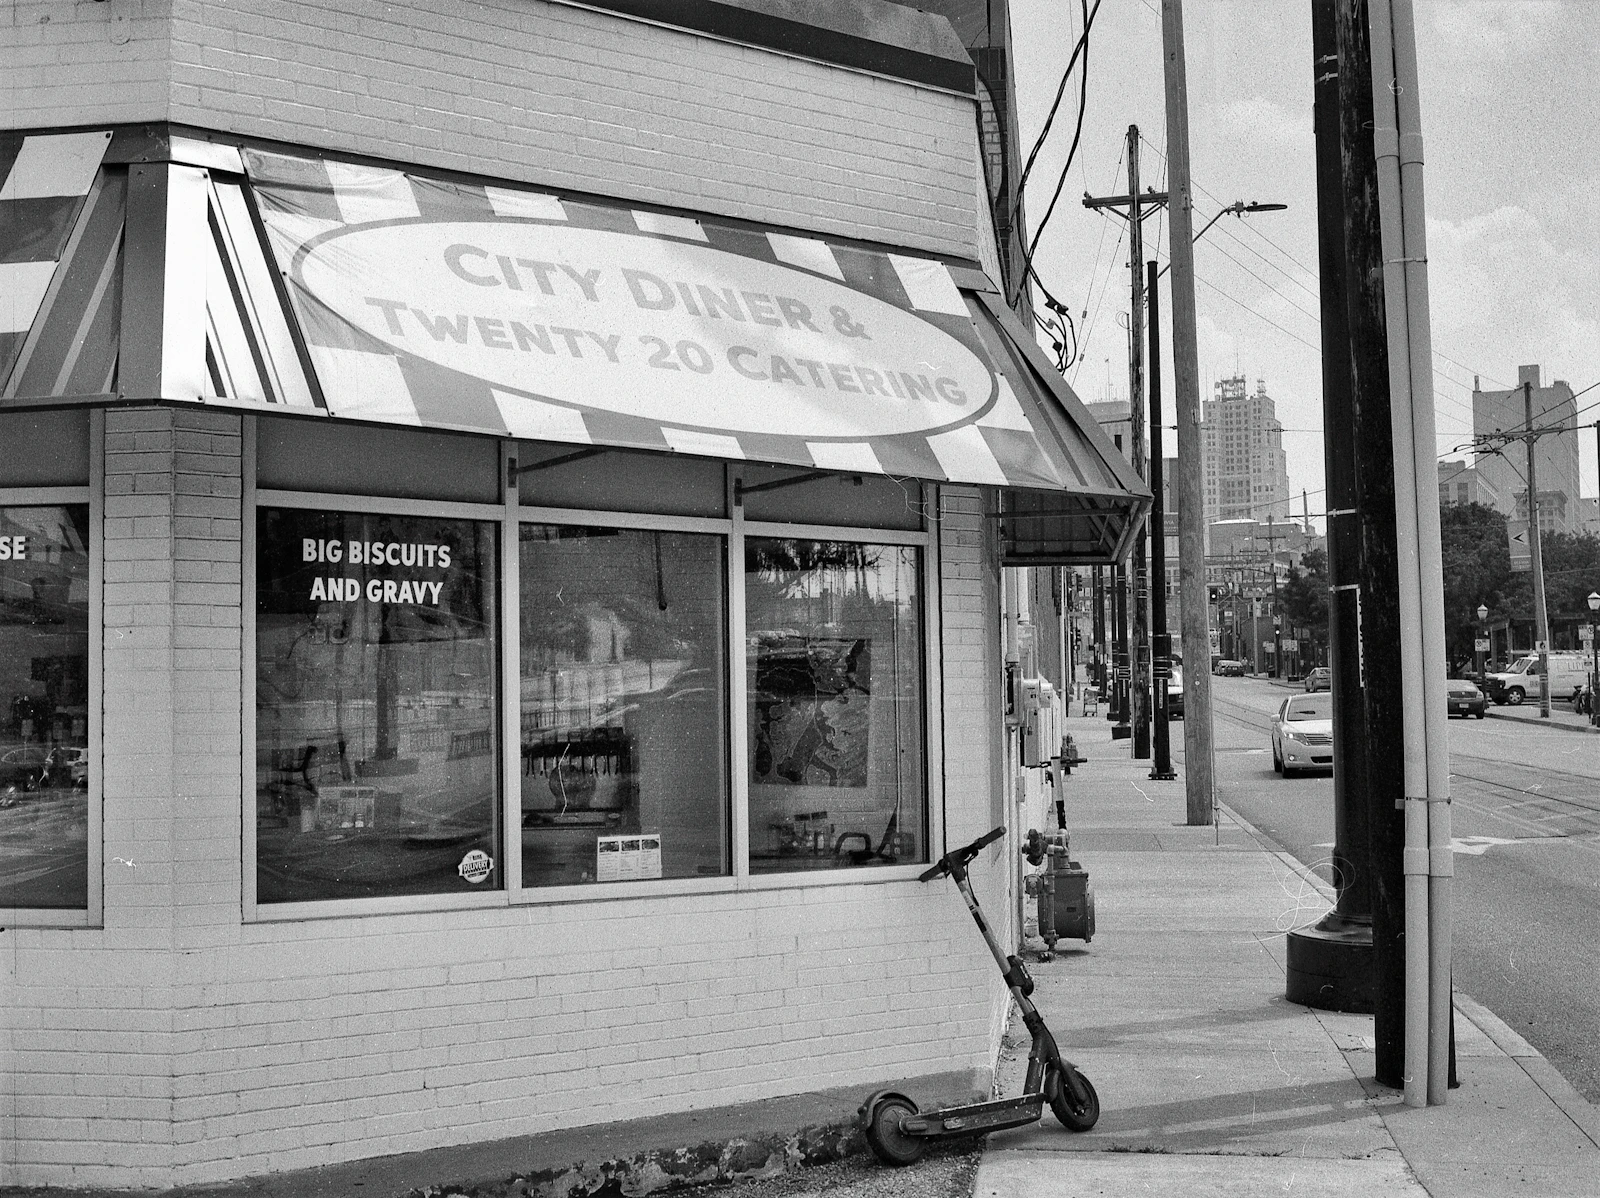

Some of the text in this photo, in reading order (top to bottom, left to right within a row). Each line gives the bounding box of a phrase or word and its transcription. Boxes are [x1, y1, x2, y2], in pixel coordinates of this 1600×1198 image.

[443, 243, 873, 340] CITY DINER &
[364, 296, 967, 406] TWENTY 20 CATERING
[302, 538, 451, 568] BIG BISCUITS
[309, 577, 444, 605] AND GRAVY
